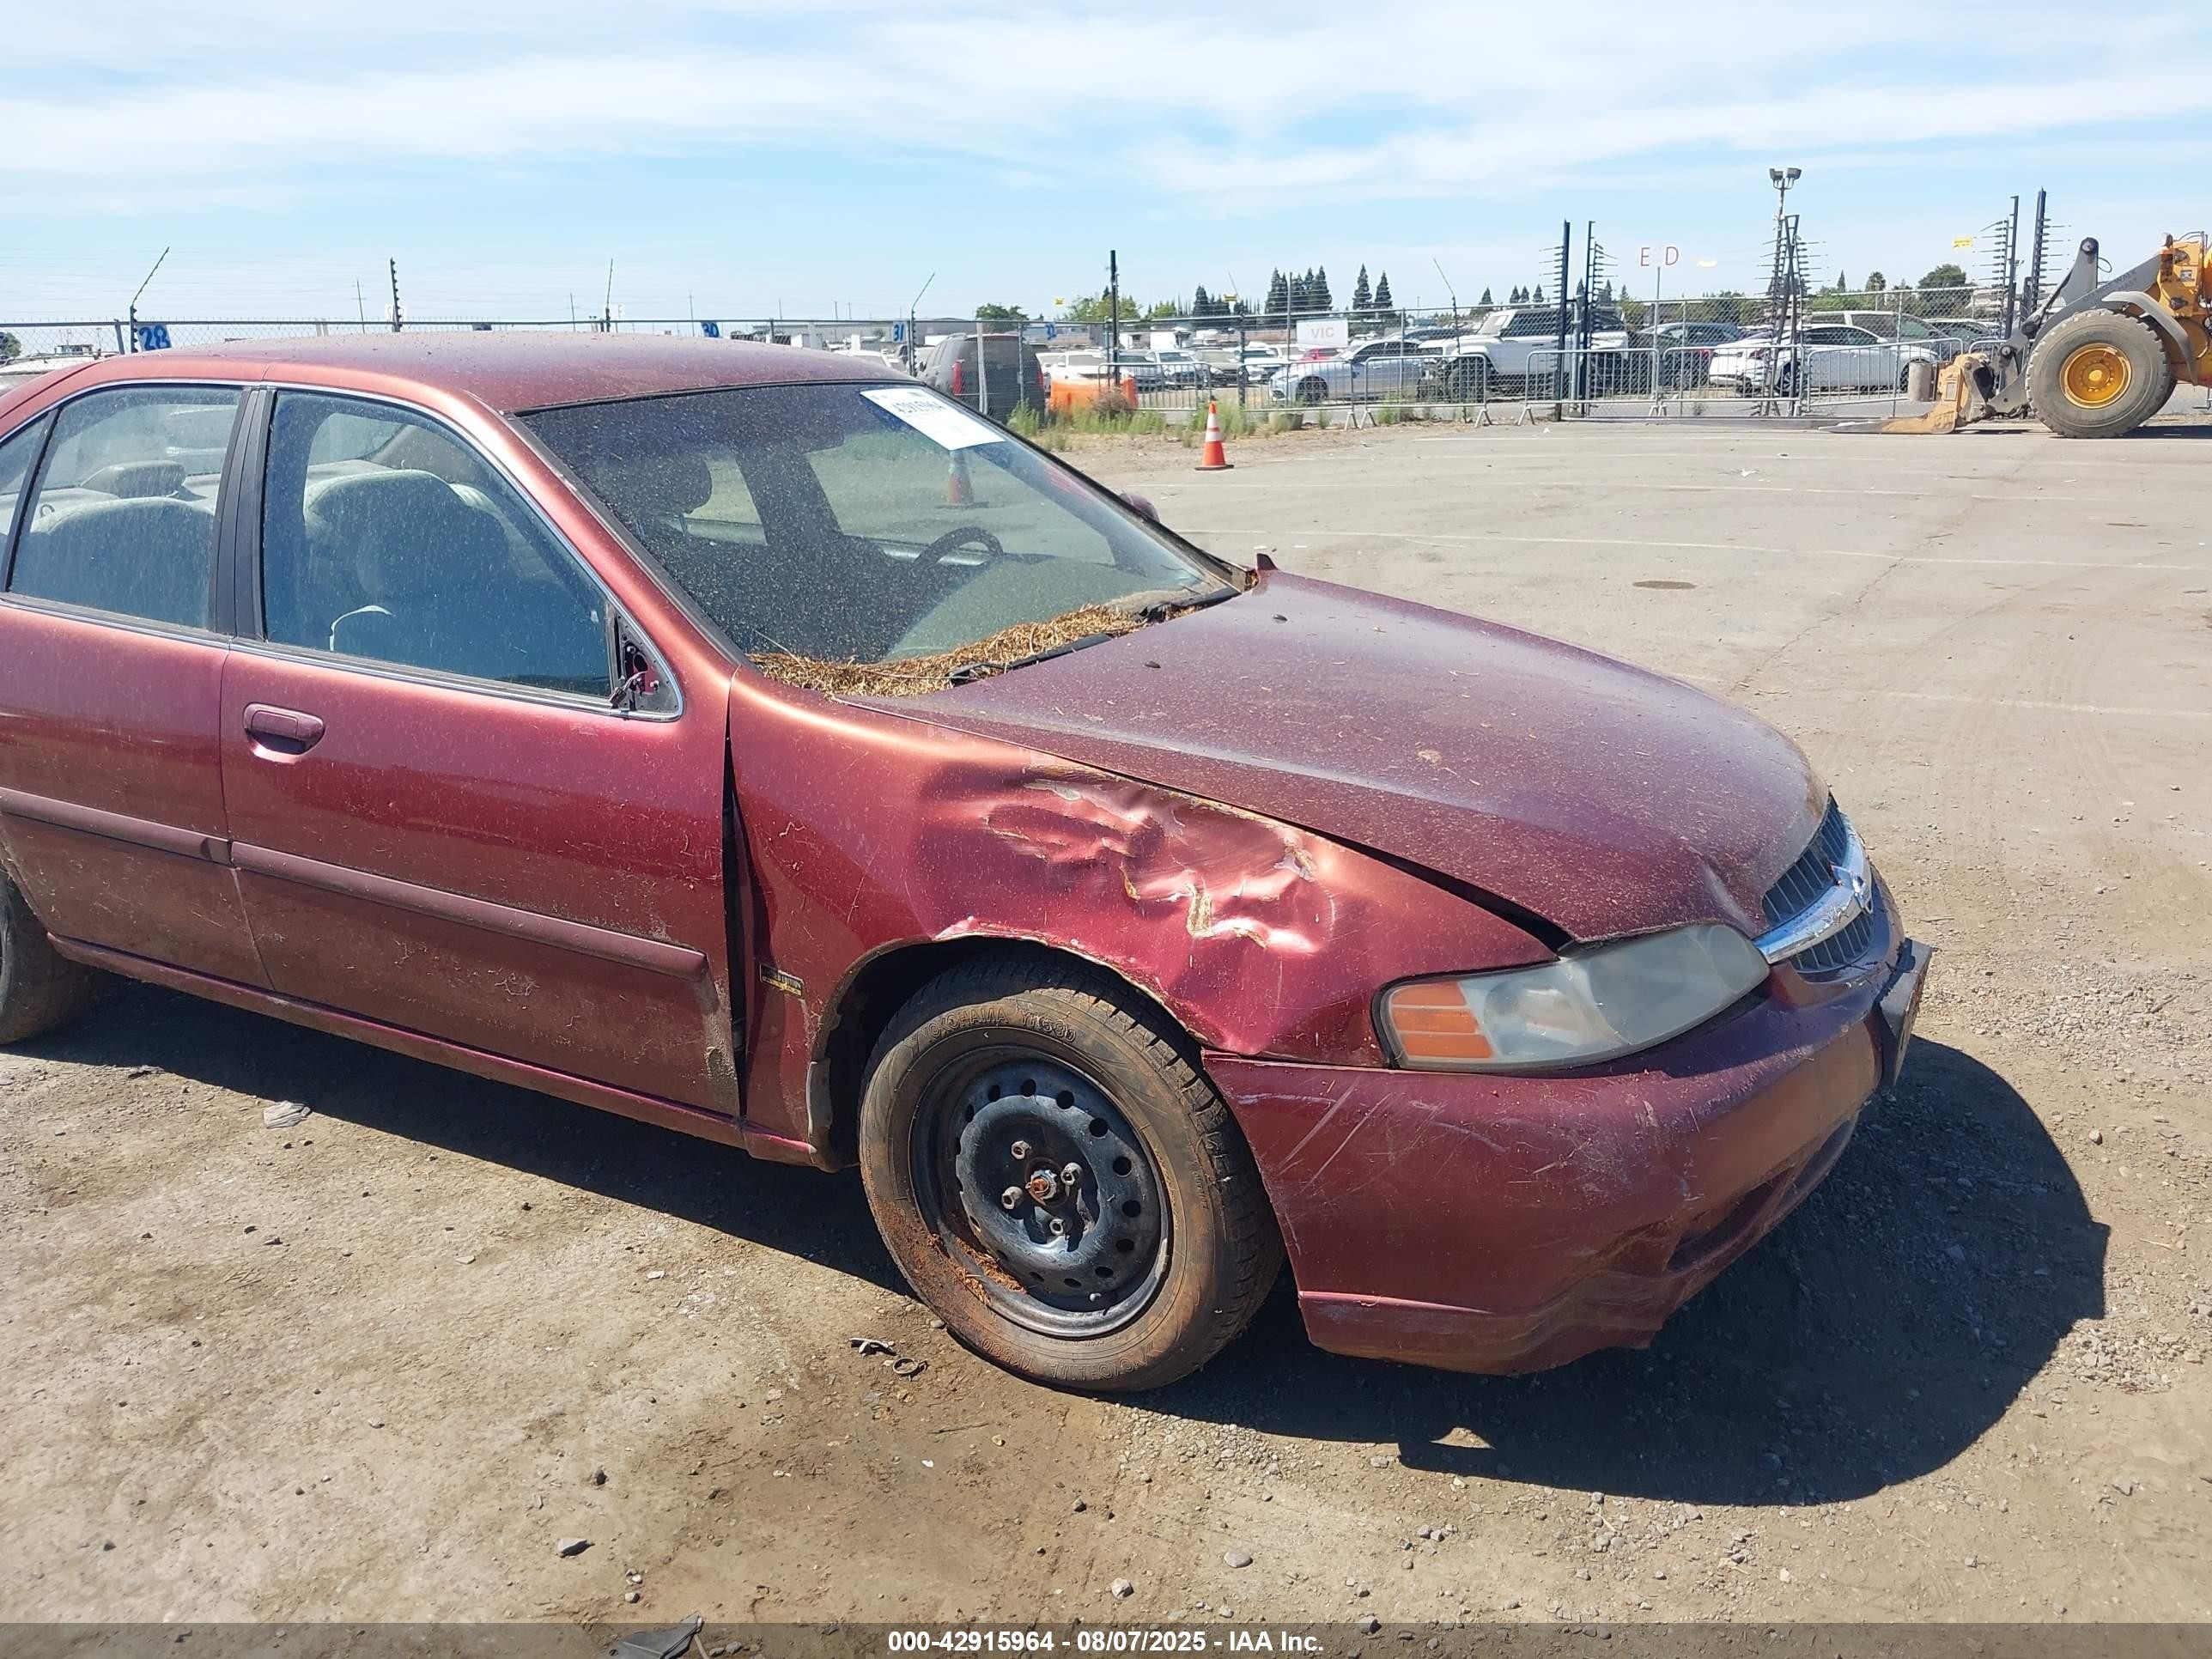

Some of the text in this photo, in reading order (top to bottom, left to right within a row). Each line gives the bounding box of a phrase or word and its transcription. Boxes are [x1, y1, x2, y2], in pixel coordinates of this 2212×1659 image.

[1640, 246, 1679, 267] E D
[138, 325, 172, 351] 28
[702, 322, 720, 337] 30
[893, 323, 904, 342] 31
[1310, 326, 1334, 338] VIC
[924, 1007, 1078, 1043] YOKOHAMA YK580
